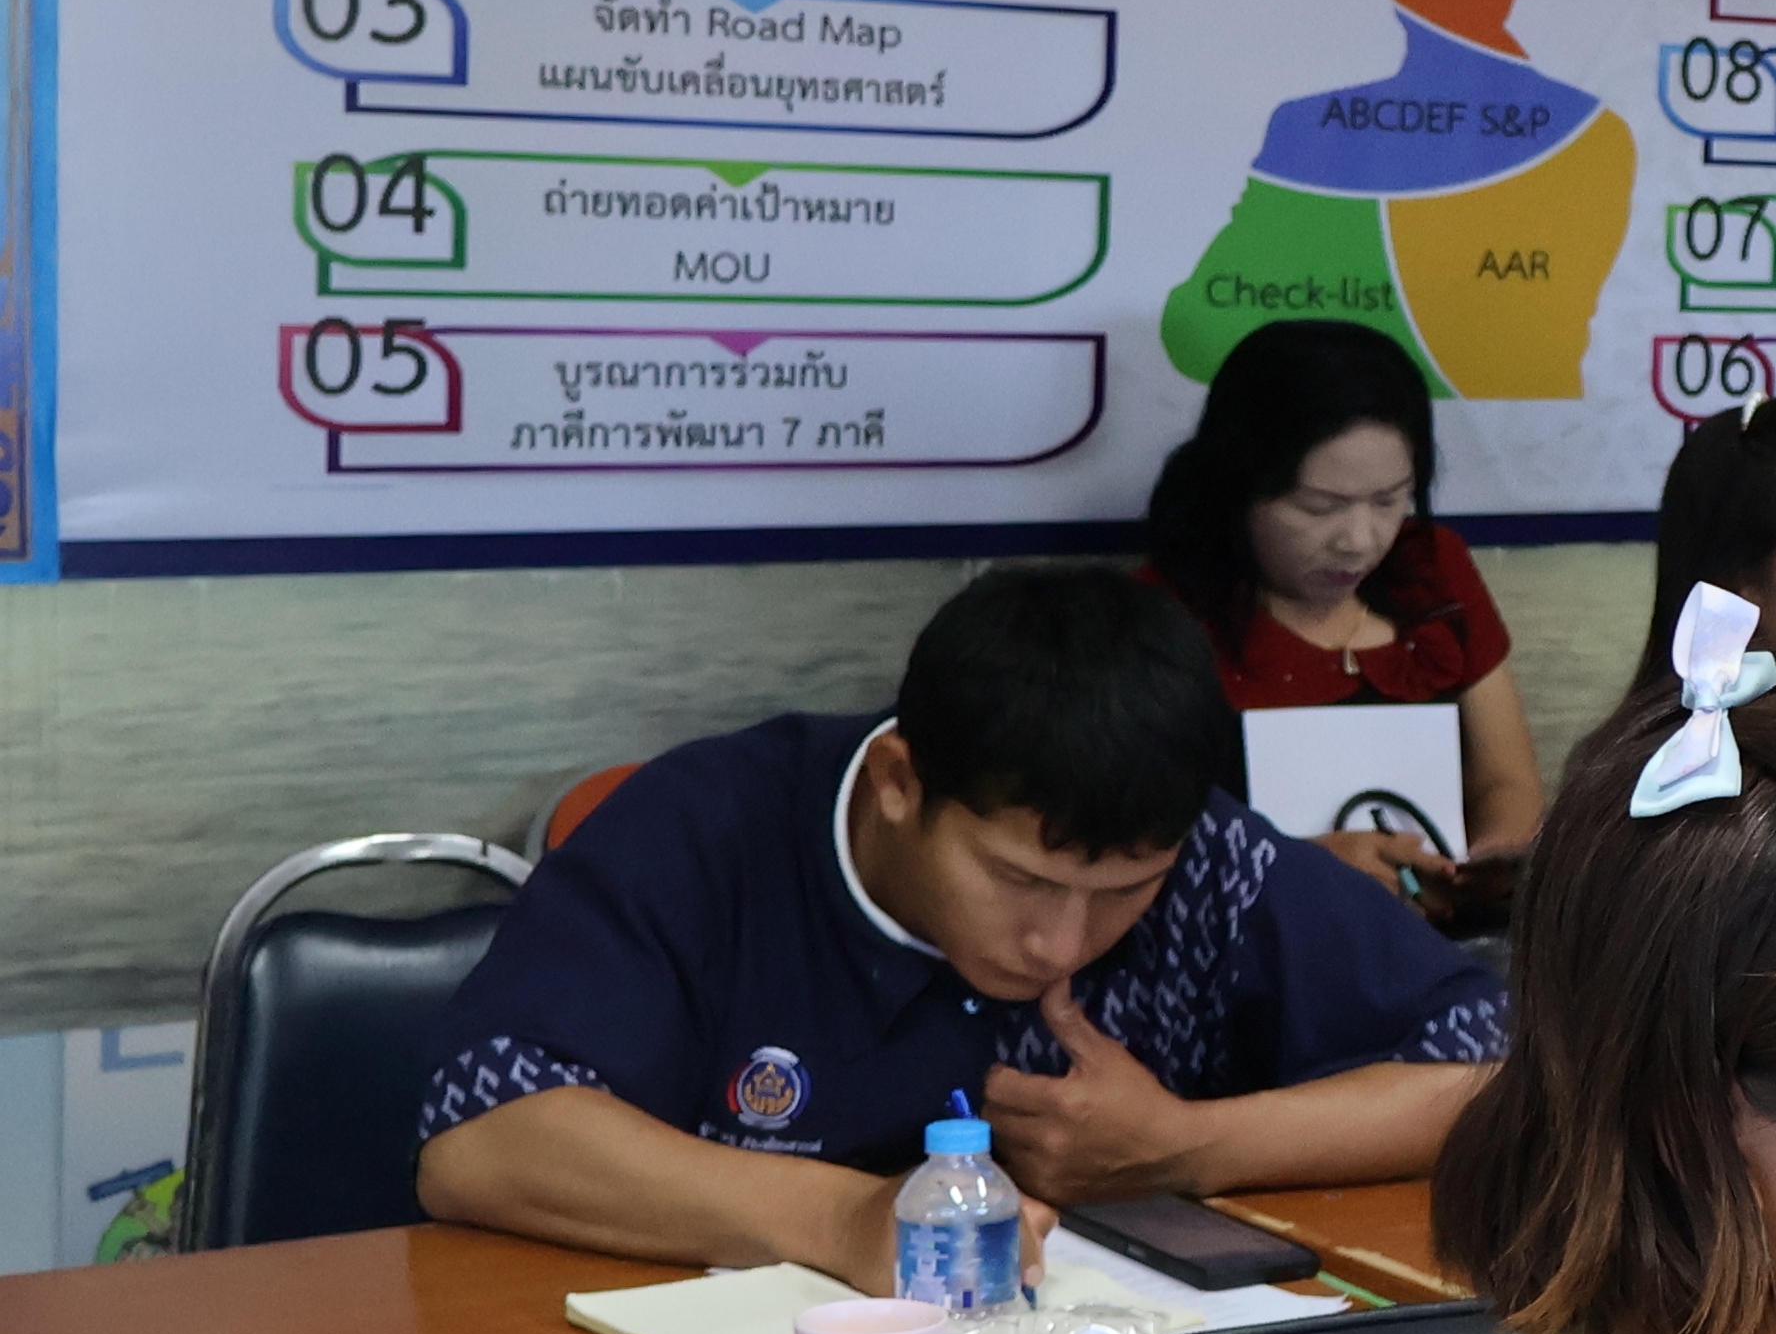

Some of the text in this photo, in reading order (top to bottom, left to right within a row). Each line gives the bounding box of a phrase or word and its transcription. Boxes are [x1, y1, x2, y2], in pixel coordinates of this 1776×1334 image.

[708, 8, 806, 45] Road
[820, 12, 903, 52] Map
[537, 50, 949, 116] แผนขับเคลื่อนยุทธศาสตร์
[1681, 38, 1764, 104] 08
[1319, 97, 1551, 138] ABCDEF S&P
[311, 153, 435, 235] 04
[543, 180, 897, 228] ถ่ายทอดค่าเป้าหมาย
[1684, 196, 1769, 263] 07
[673, 251, 771, 286] MOU
[1477, 250, 1551, 281] AAR
[1204, 273, 1396, 313] Check-list
[303, 317, 429, 399] 05
[554, 353, 849, 405] บูรณาการร่วมกับ
[1675, 333, 1755, 397] 06
[509, 407, 887, 452] ภาคีการพัฒนา 7 ภาคี
